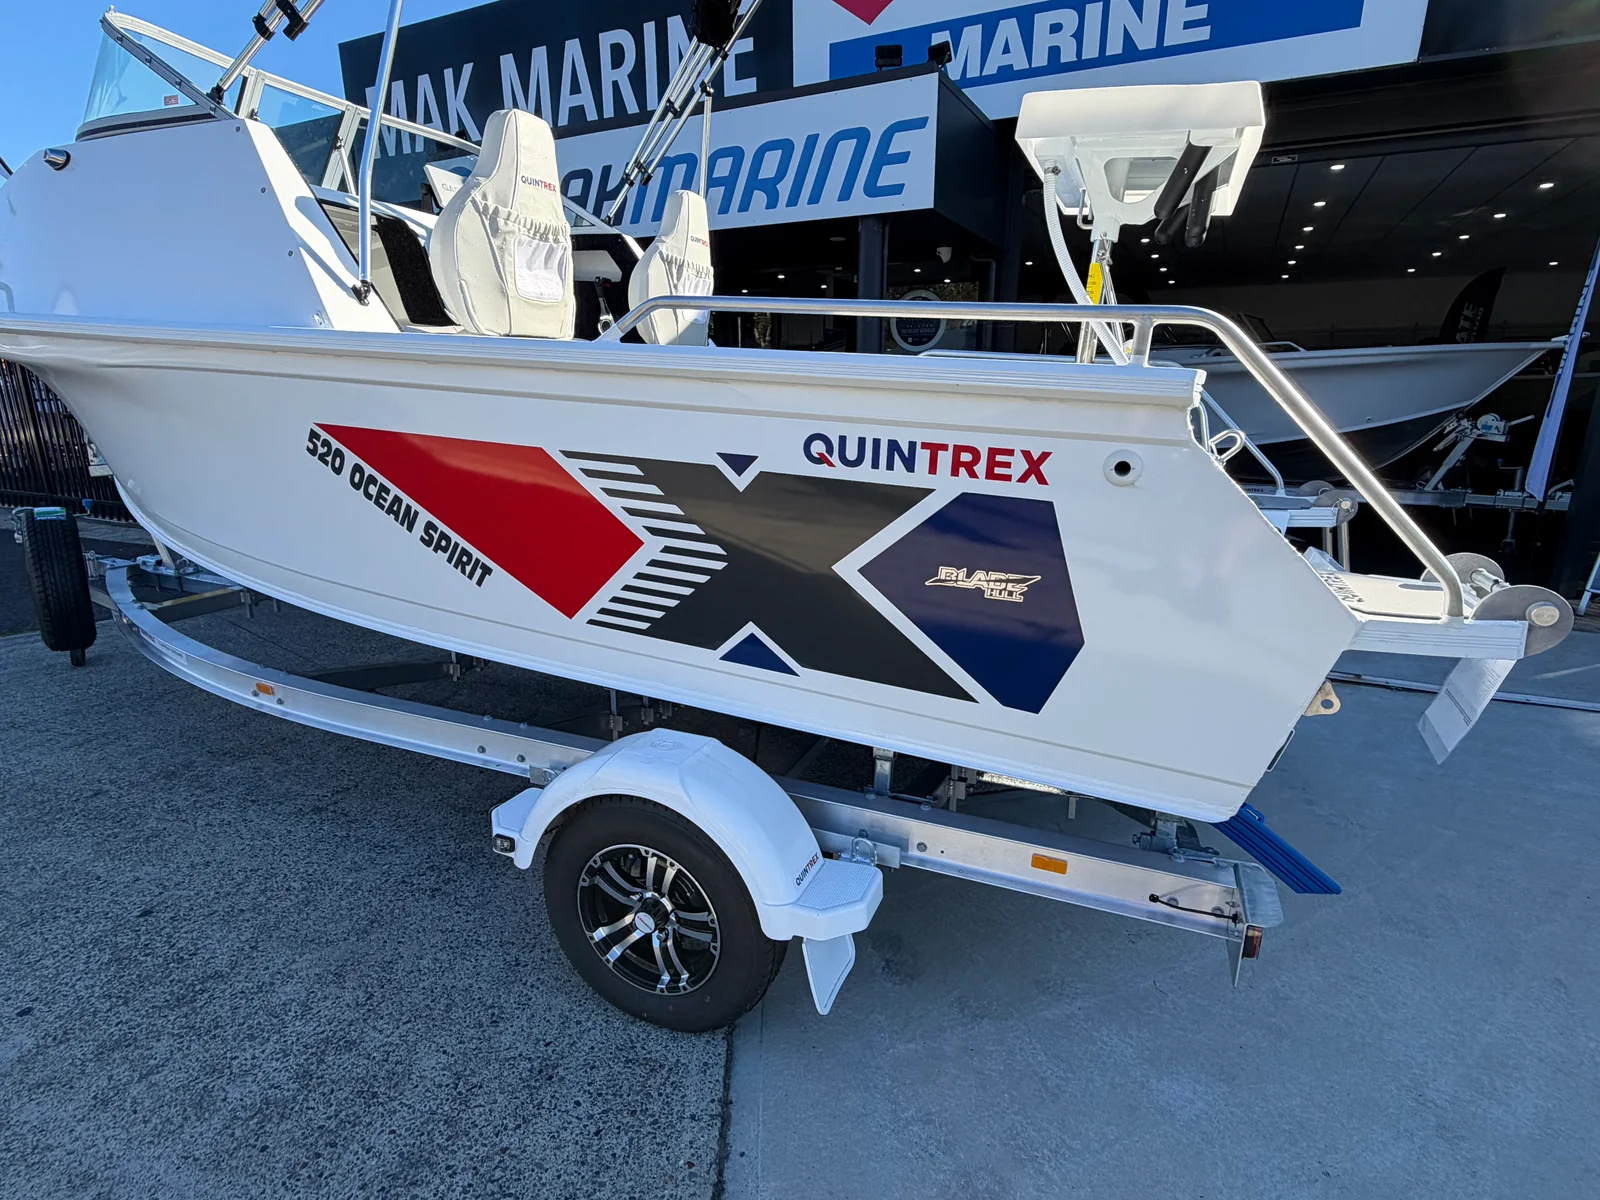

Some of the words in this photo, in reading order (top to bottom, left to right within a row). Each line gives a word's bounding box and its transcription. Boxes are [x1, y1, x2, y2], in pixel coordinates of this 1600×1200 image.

[931, 0, 1211, 80] MARINE
[365, 62, 482, 159] MAK
[500, 0, 757, 127] MARINE
[521, 175, 557, 193] QUINTREX
[803, 432, 1053, 486] QUINTREX
[305, 427, 346, 476] 520
[349, 462, 420, 534] OCEAN
[419, 520, 494, 588] SPIRIT
[925, 566, 1041, 590] BLADE
[986, 588, 1021, 600] HULL
[795, 852, 819, 886] QUINTREX
